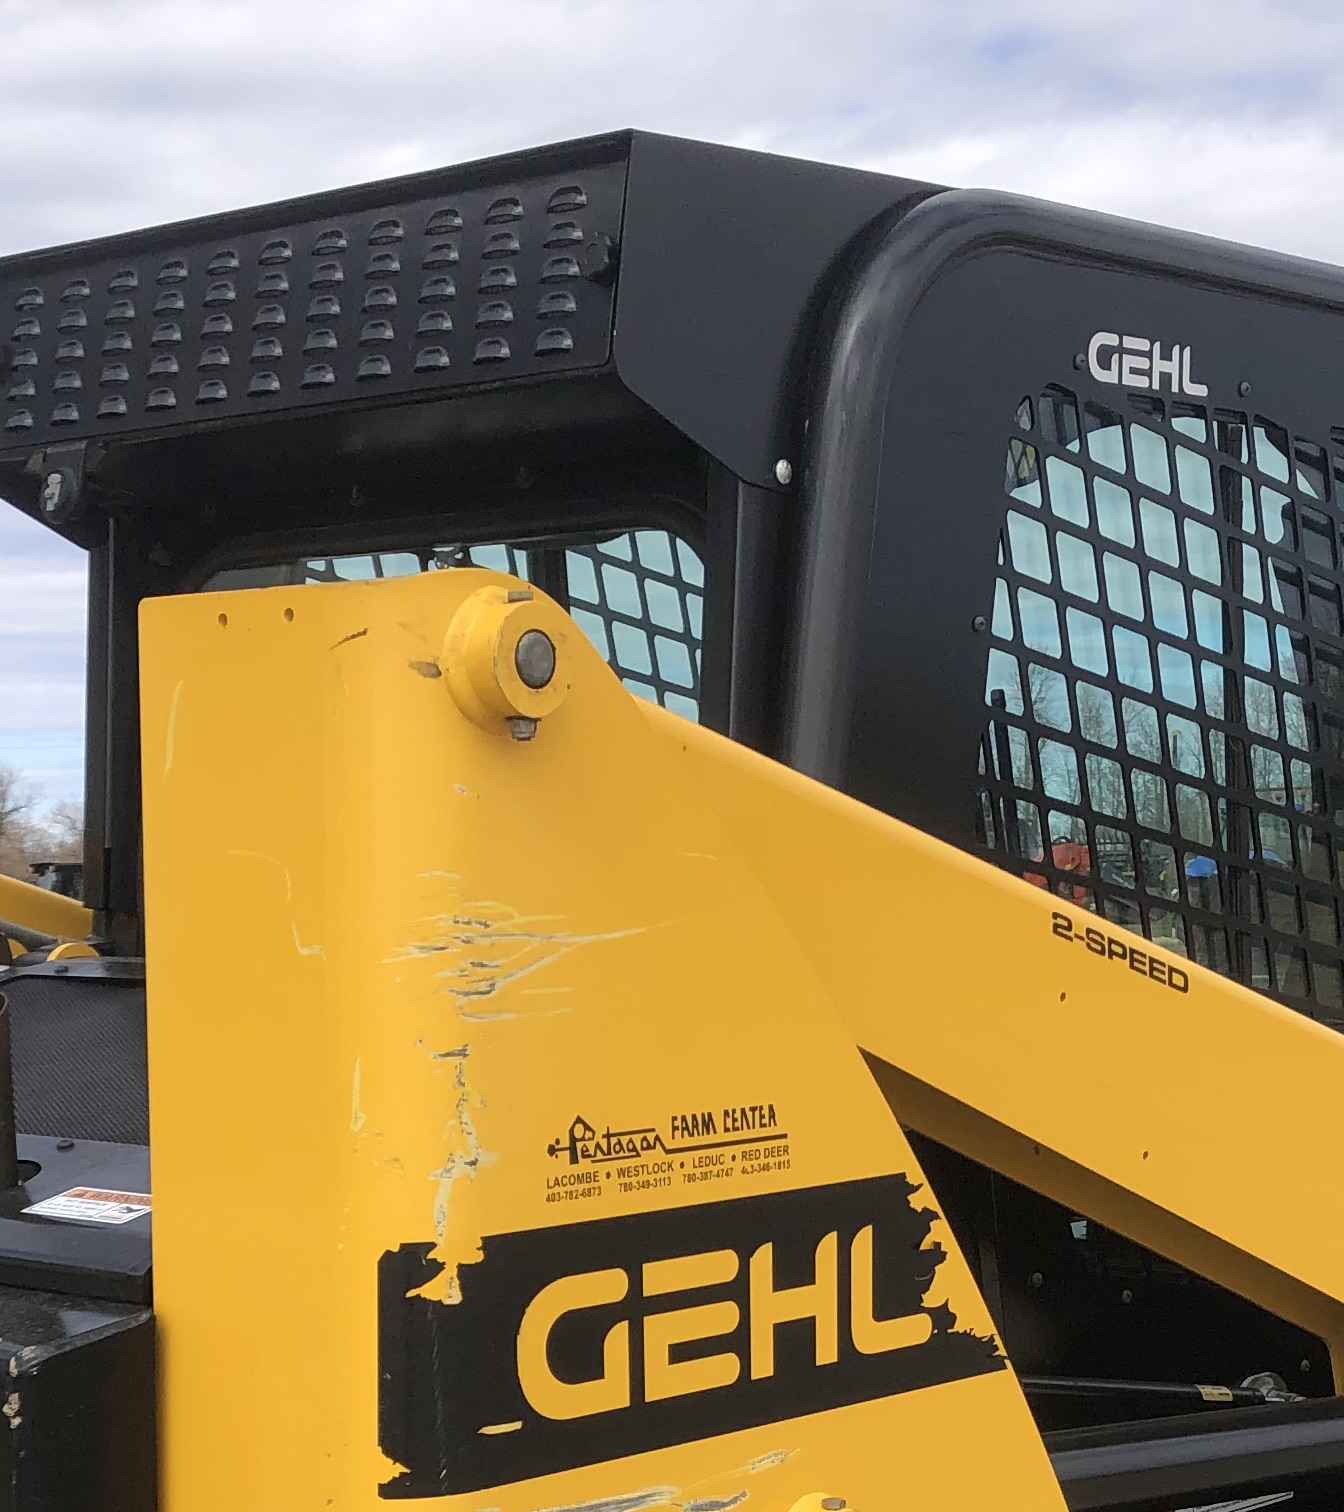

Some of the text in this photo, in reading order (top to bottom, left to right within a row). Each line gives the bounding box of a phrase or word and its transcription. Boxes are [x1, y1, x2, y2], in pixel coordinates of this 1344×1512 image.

[1088, 331, 1209, 397] GEHL
[1051, 911, 1189, 993] 2-SPEED
[546, 1145, 790, 1189] LACOMBE WESTLOCK LEDUC RED DEER
[568, 1103, 778, 1165] Pentagon FARM CENTER
[517, 1224, 933, 1420] GEHL
